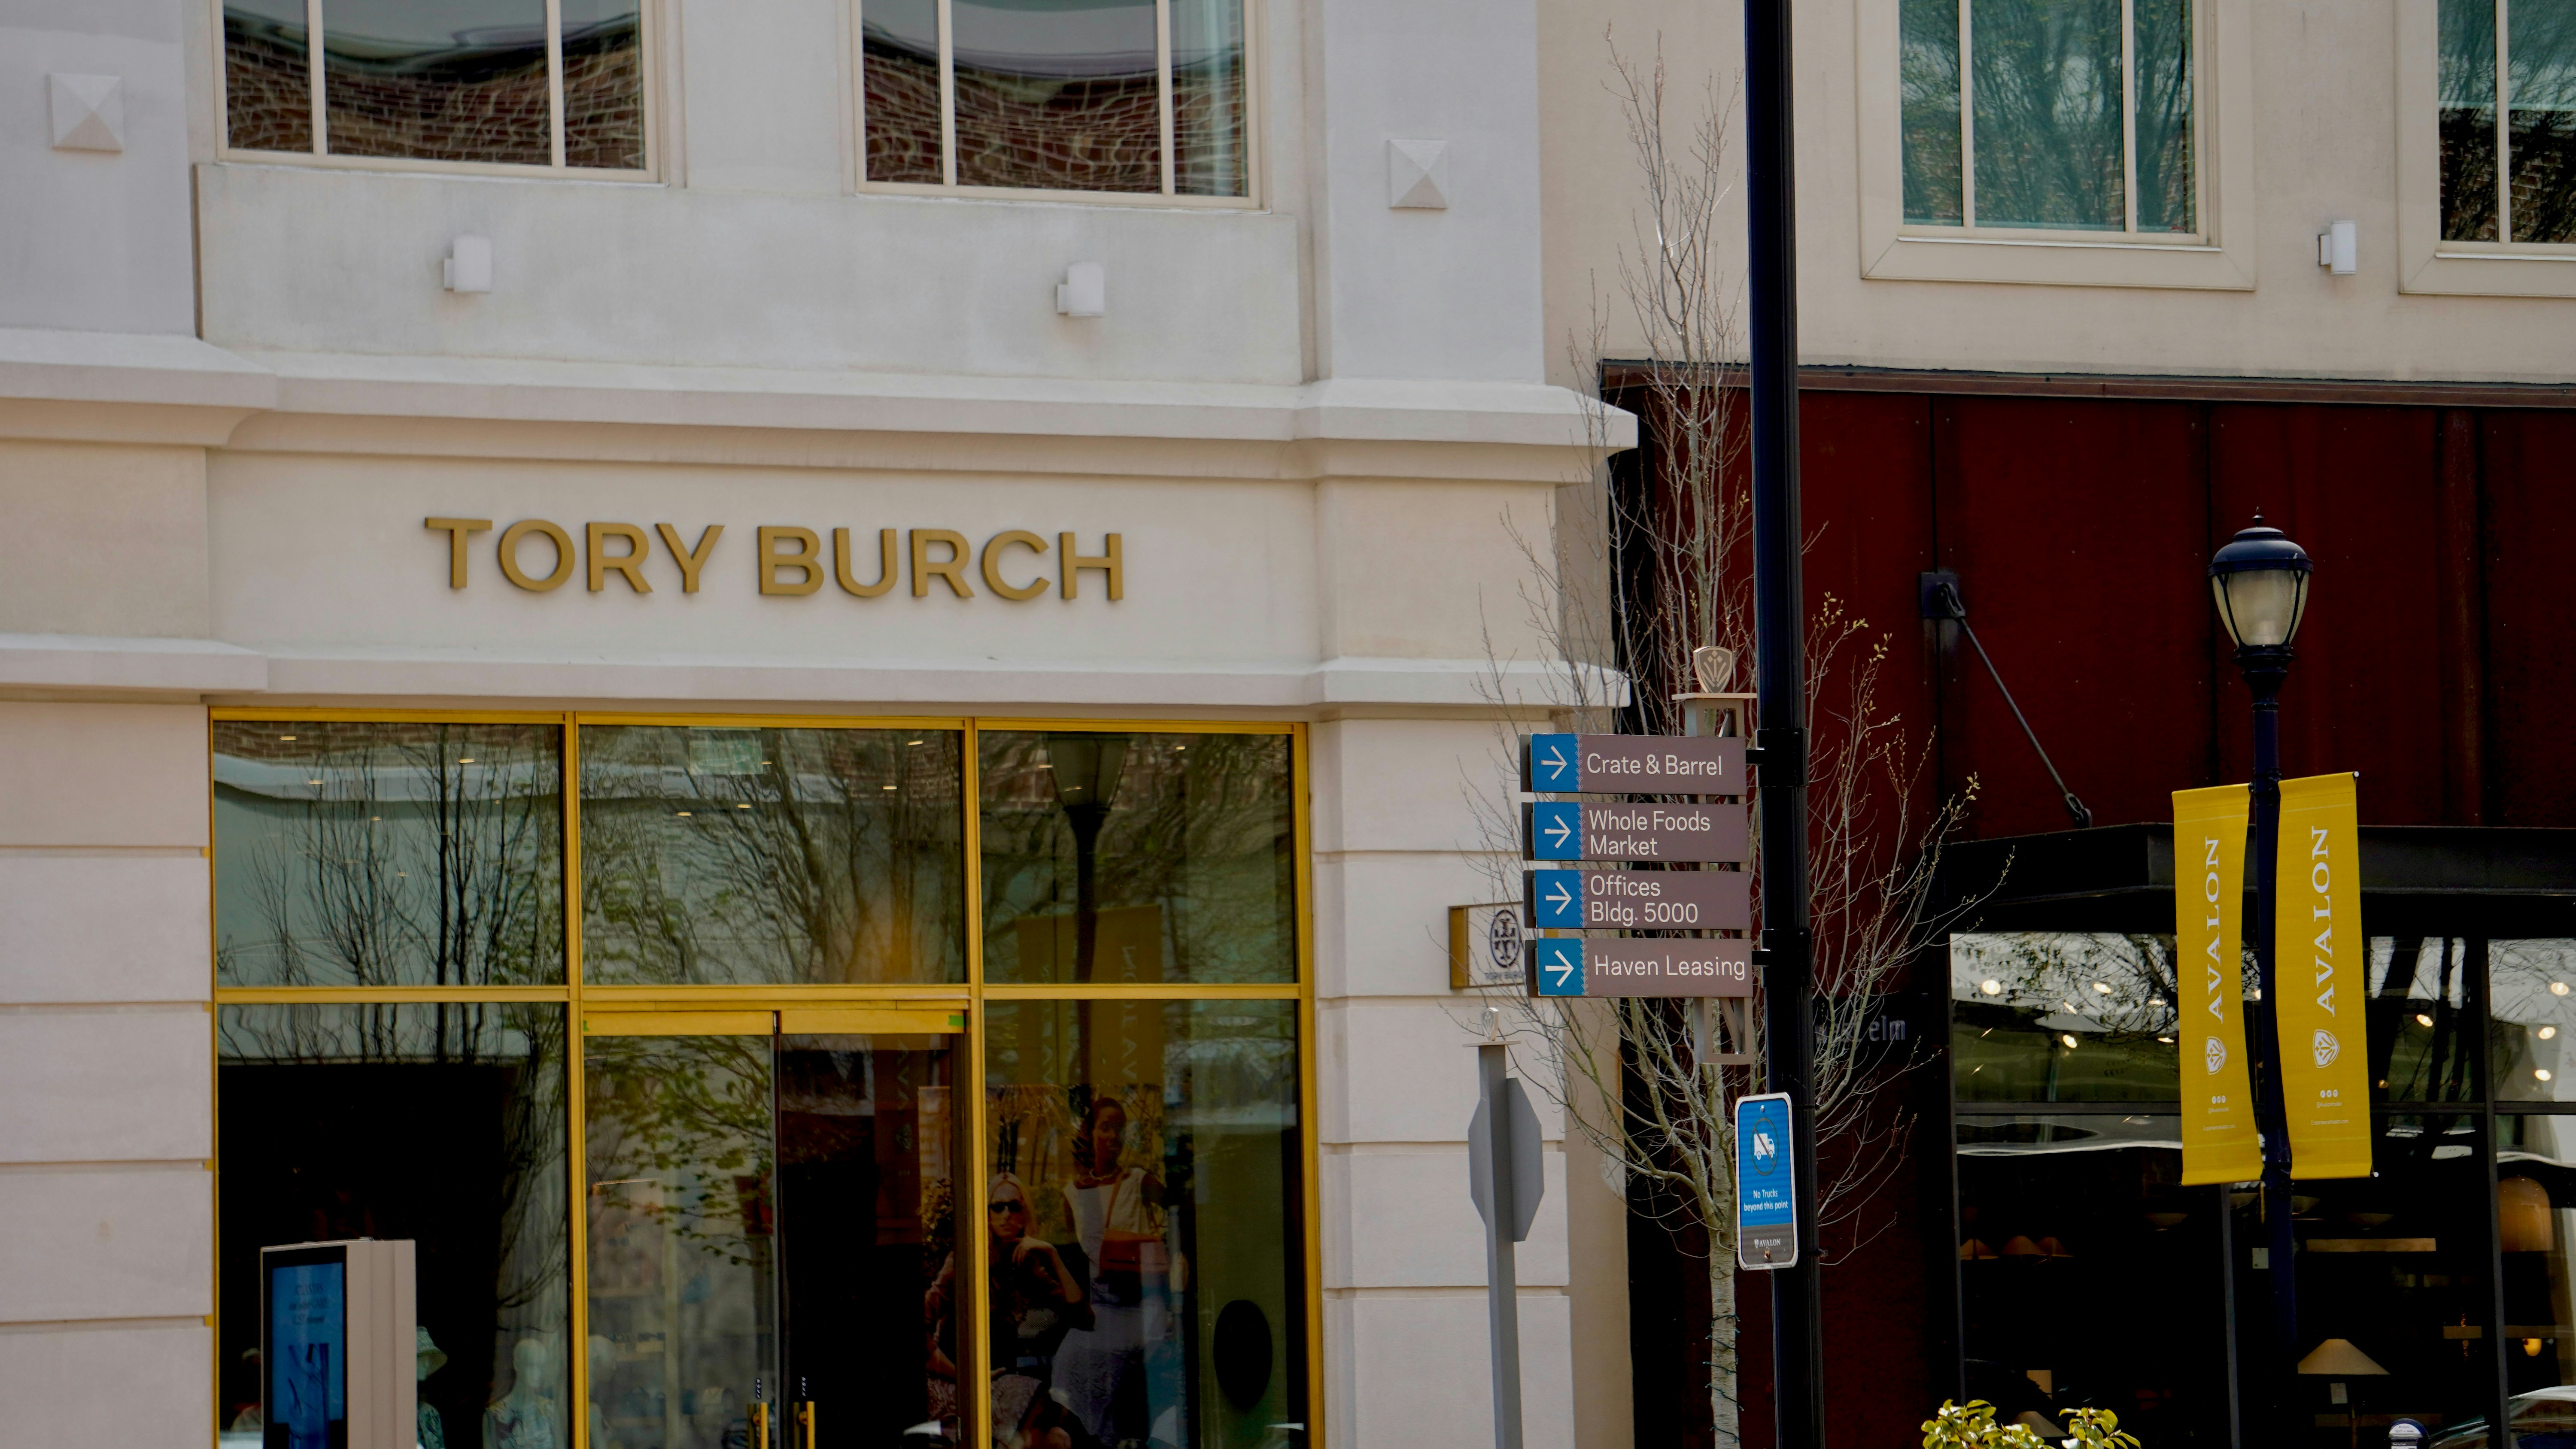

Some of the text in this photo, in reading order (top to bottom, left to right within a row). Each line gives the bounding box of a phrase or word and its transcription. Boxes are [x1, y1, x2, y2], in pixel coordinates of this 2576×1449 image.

[423, 517, 1124, 602] TORY BURCH
[1587, 753, 1722, 776] Crate & Barrel
[1589, 809, 1710, 831] Whole Foods
[1590, 834, 1658, 855] Market
[1590, 875, 1661, 897] Offices
[1591, 901, 1698, 927] Bldg. 5000
[2312, 825, 2335, 1017] AVALON
[2205, 836, 2224, 1024] AVALON
[1595, 955, 1745, 981] Haven Leasing
[1869, 1015, 1905, 1041] elm
[1753, 1188, 1778, 1199] No Trucks
[1744, 1200, 1788, 1213] beyond this point
[1759, 1239, 1781, 1247] AVALON
